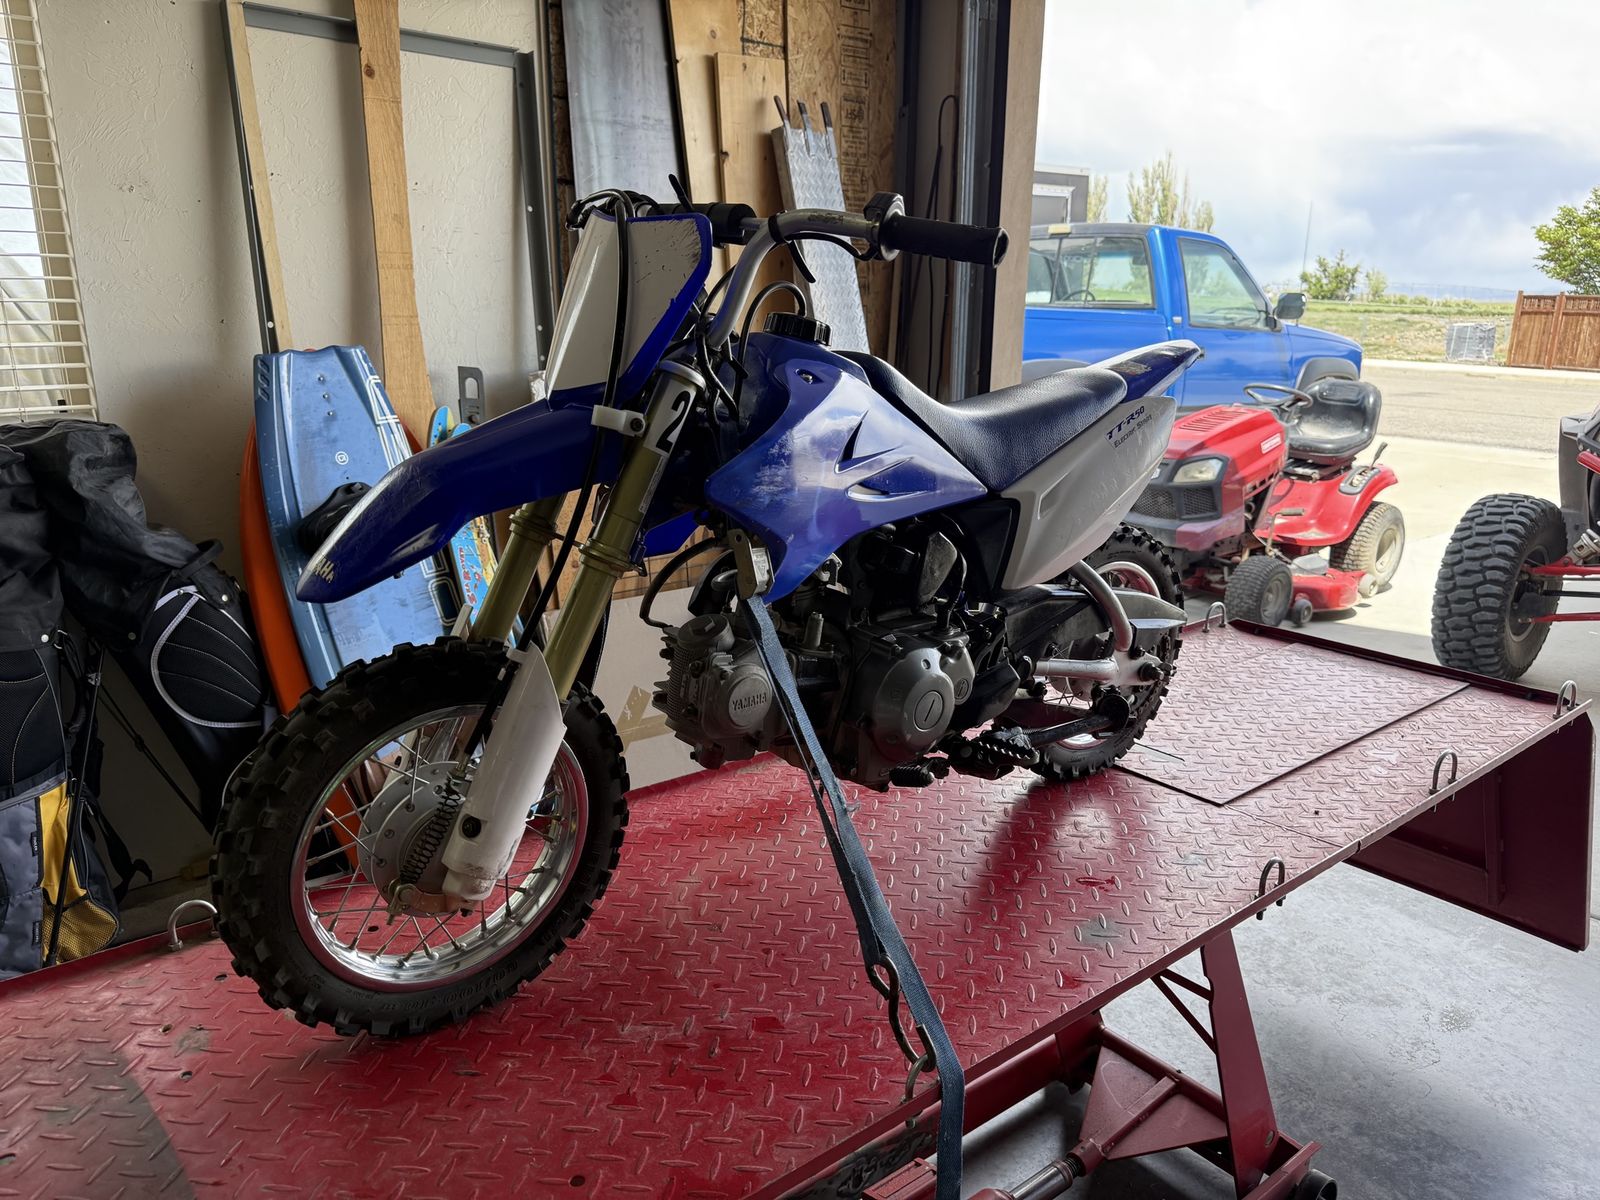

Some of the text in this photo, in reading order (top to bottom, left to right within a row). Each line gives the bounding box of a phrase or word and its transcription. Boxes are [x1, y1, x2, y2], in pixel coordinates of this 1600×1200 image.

[655, 390, 691, 454] 2
[1106, 405, 1145, 440] TT-R50
[732, 692, 767, 711] YAMAHA
